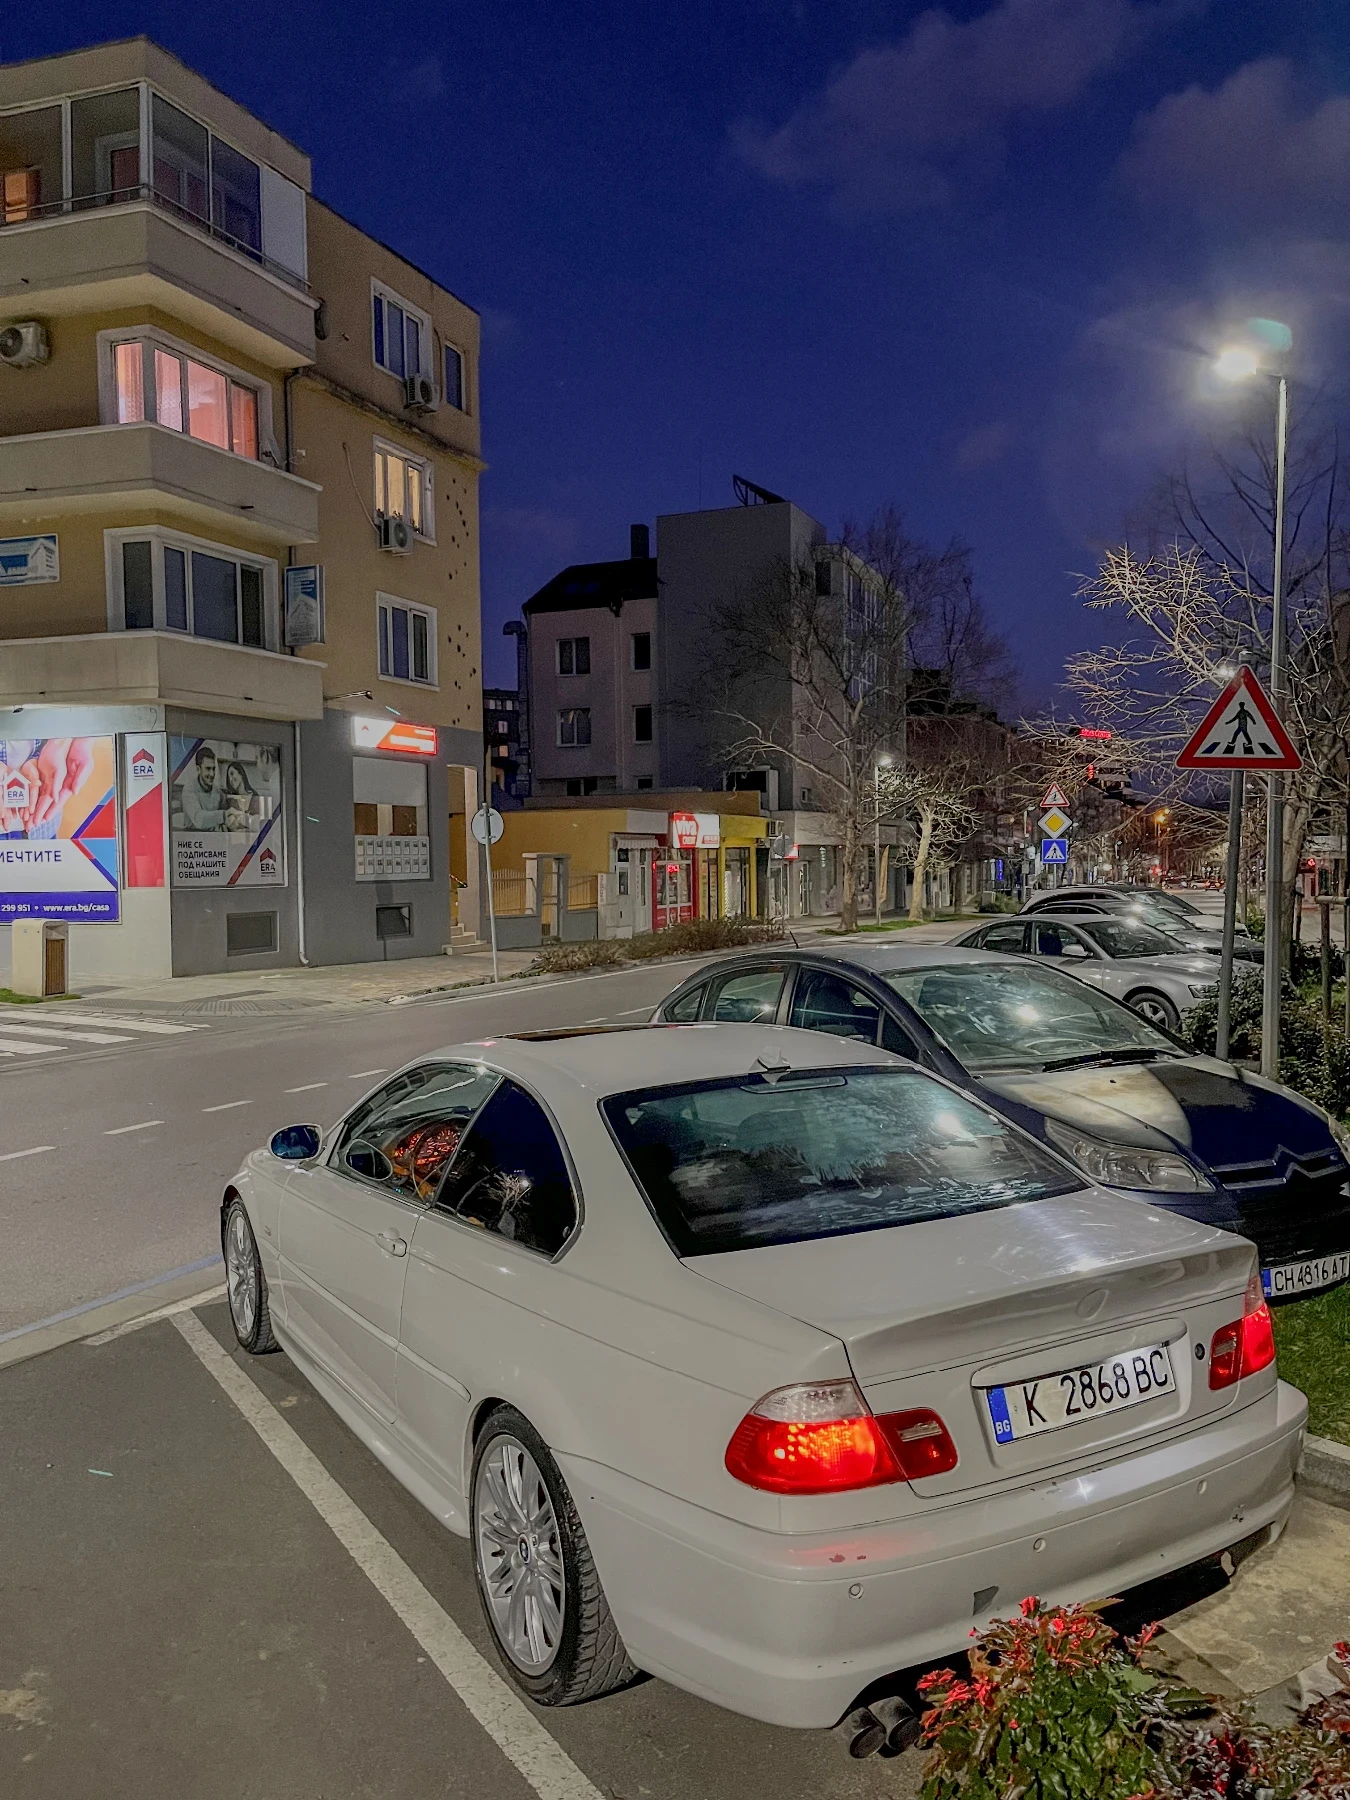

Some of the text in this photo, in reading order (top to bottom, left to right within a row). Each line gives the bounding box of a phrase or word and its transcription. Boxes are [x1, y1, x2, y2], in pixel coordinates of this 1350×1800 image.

[133, 765, 154, 775] ERA
[7, 790, 25, 798] ERA
[177, 841, 203, 849] НИЕ СЕ
[177, 851, 227, 859] ПОДПИСВАМЕ
[178, 860, 226, 869] ПОД НАШИТЕ
[260, 863, 276, 872] ERA
[178, 870, 220, 879] ОБЕЩАНИЯ
[1, 903, 110, 913] 299 951 www.era.bg/casa
[1274, 1256, 1347, 1292] CH 4816 AT
[1022, 1349, 1168, 1427] K 2868 BC
[995, 1419, 1011, 1434] BG
